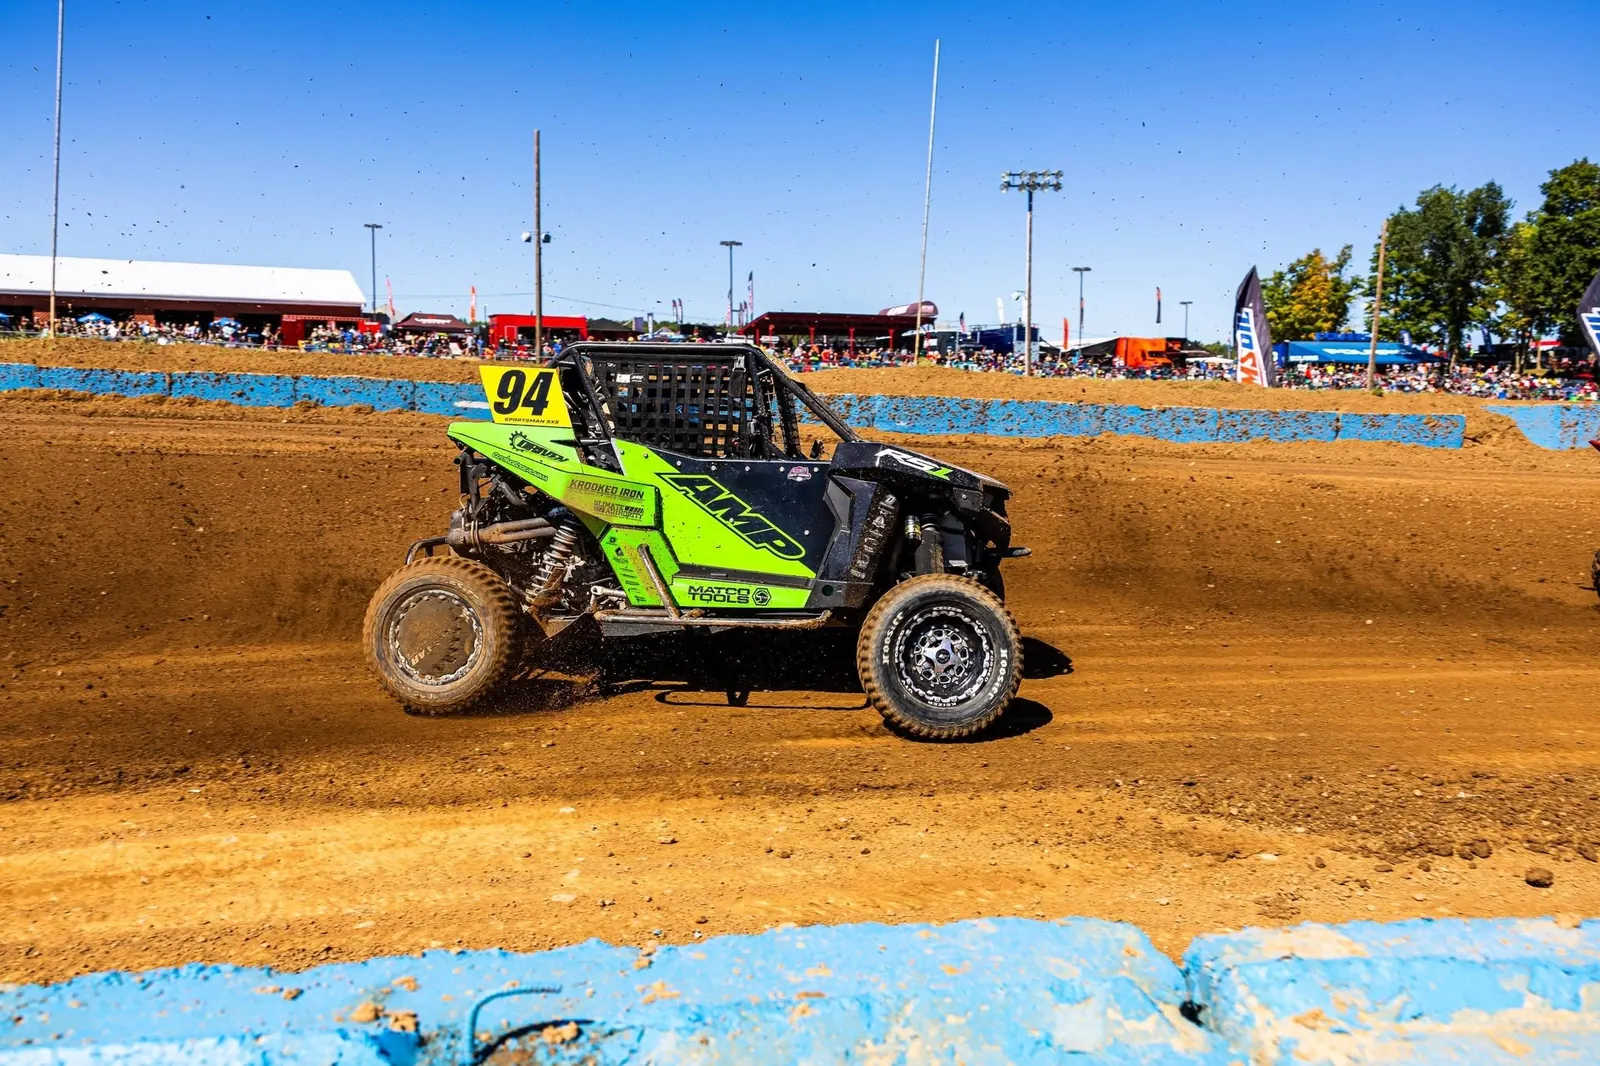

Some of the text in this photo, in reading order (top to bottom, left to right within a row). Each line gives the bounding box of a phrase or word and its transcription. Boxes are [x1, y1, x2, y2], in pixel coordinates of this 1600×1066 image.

[1236, 309, 1259, 384] MSOIL
[493, 369, 554, 416] 94
[516, 439, 570, 463] DRIVEN
[569, 479, 619, 495] KROOKED
[620, 487, 645, 499] IRON
[656, 474, 806, 559] AMP
[688, 585, 751, 596] MATCO
[688, 592, 750, 604] TOOLS
[984, 650, 994, 683] FORGED
[987, 647, 1008, 700] Hoosier
